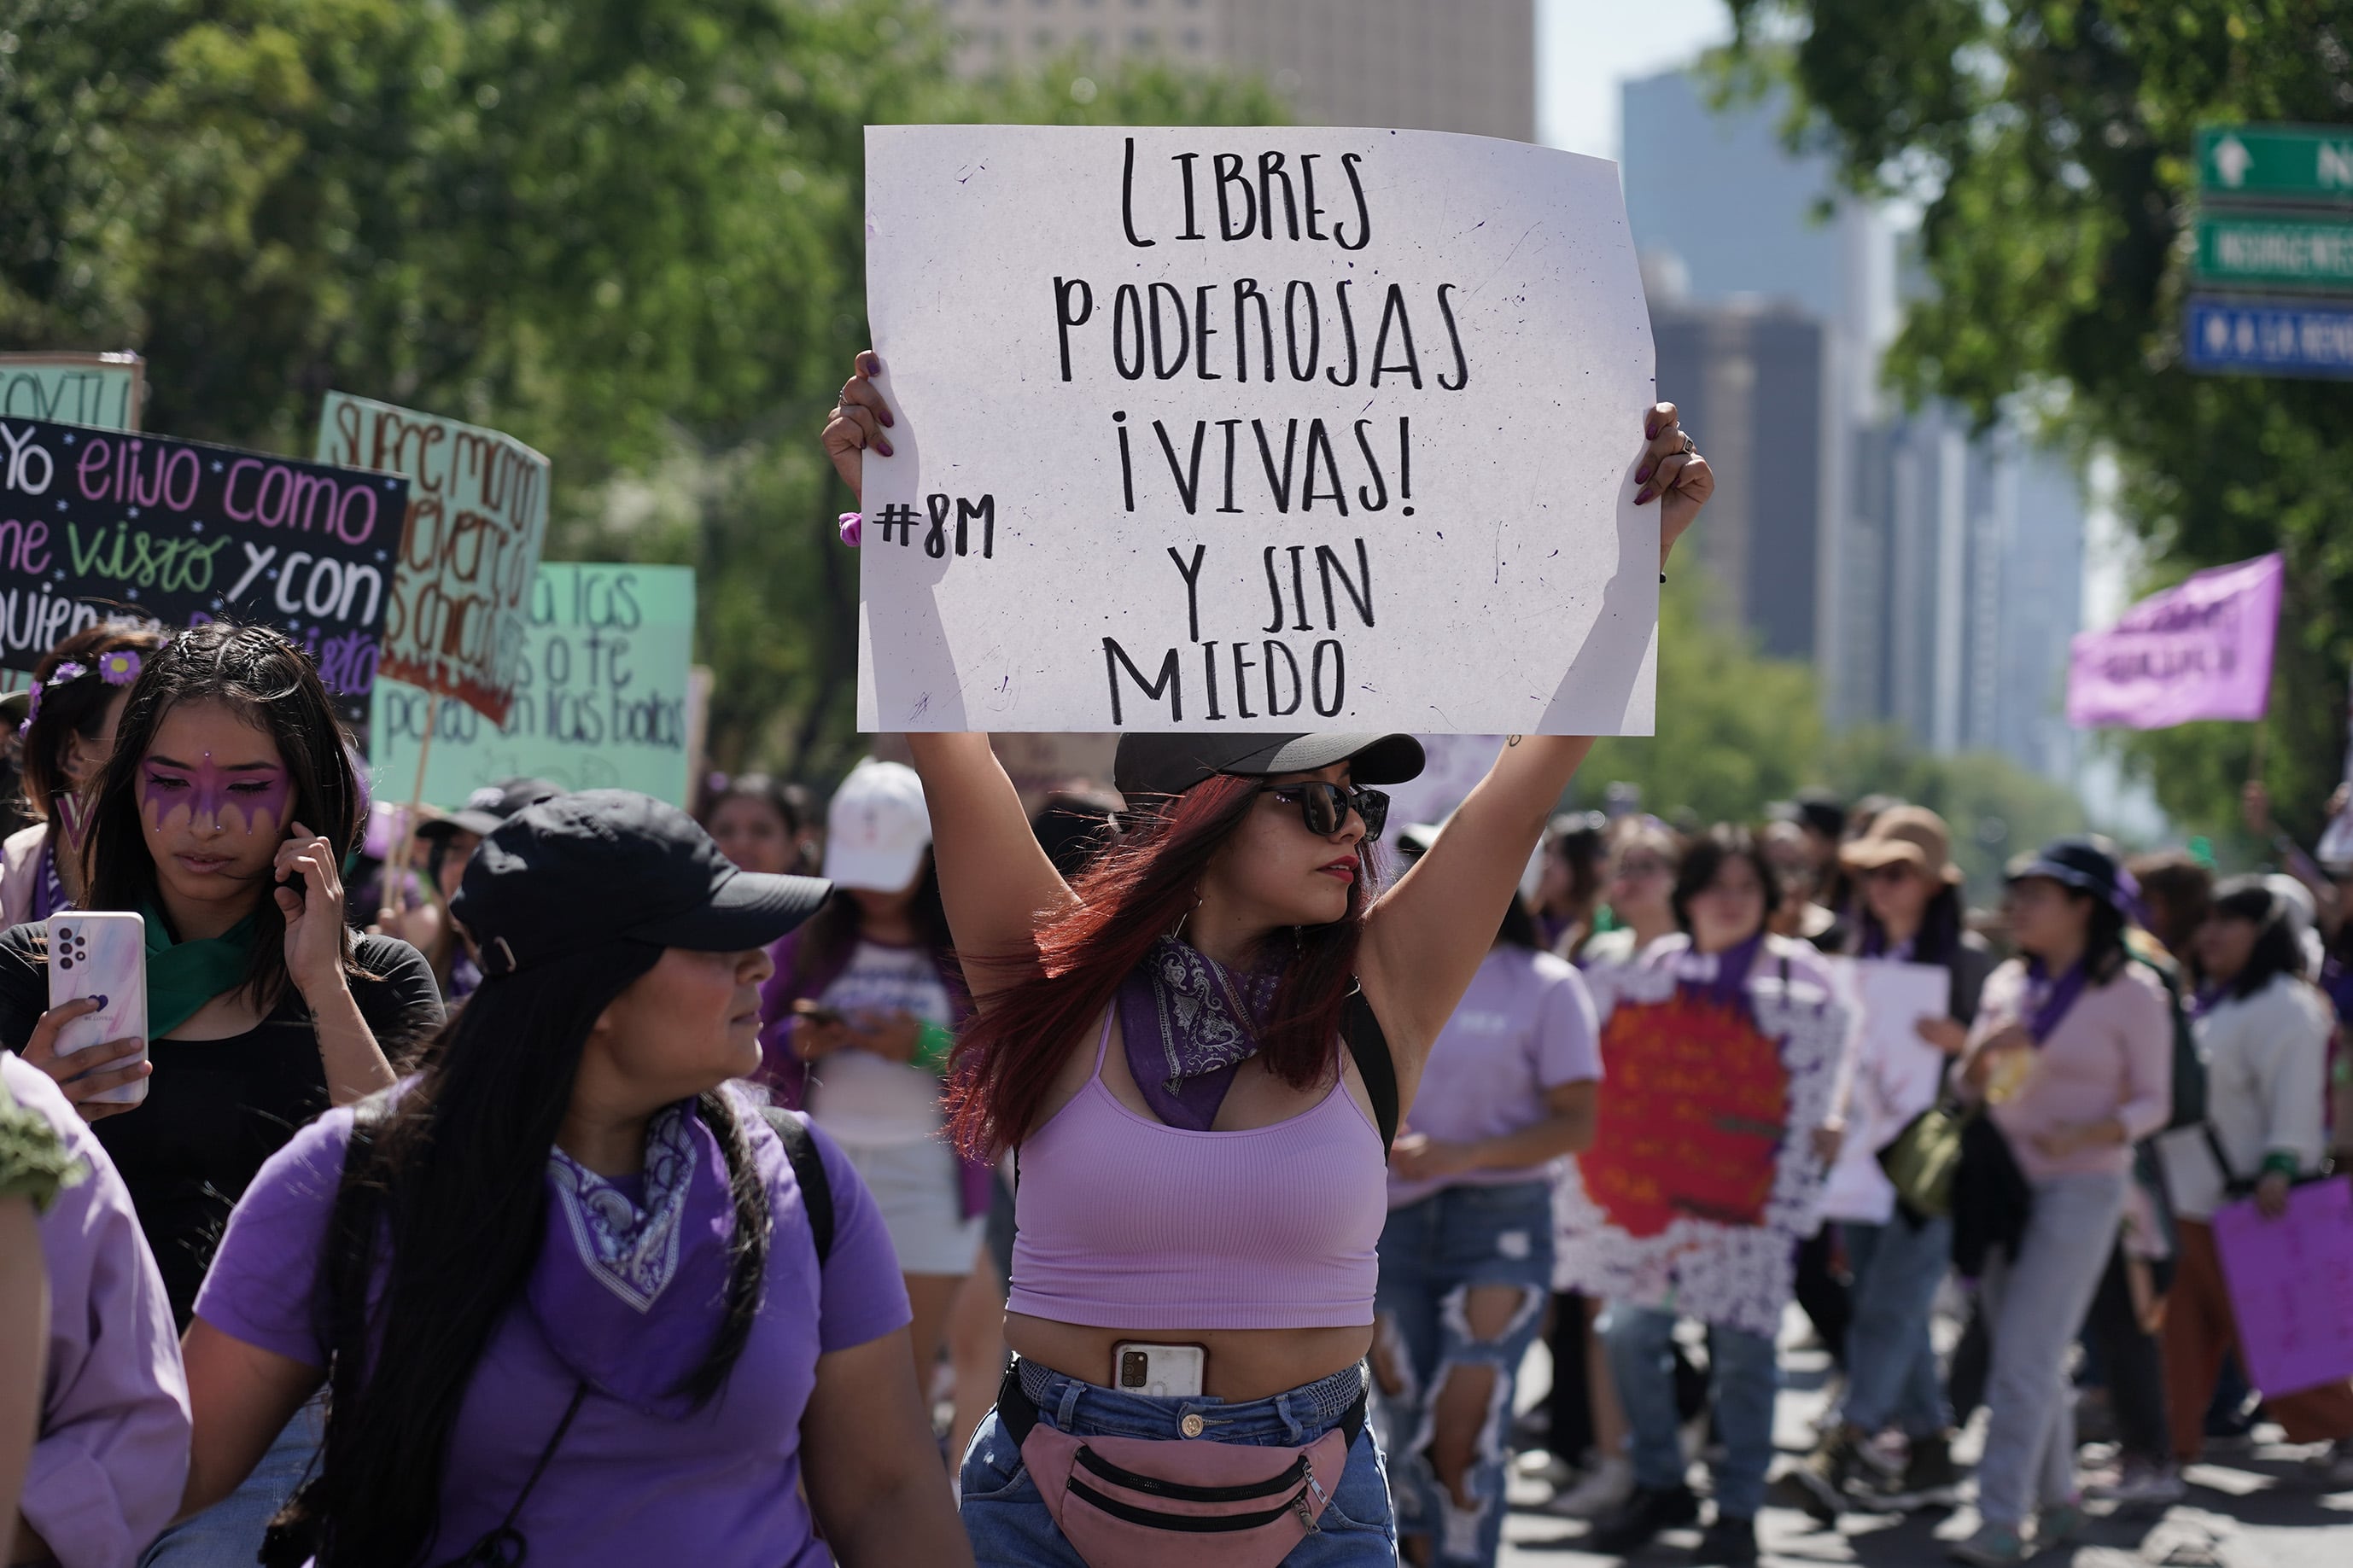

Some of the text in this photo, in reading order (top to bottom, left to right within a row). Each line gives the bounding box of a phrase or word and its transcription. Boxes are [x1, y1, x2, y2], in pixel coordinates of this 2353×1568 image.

[1121, 137, 1371, 251] LIBRES
[1053, 276, 1469, 391] PODEROSAS
[0, 421, 54, 495] Yo
[76, 437, 201, 511] elijo
[223, 458, 377, 545] como
[1112, 410, 1416, 517] ¡VIVAS!
[872, 493, 996, 559] #8M
[573, 564, 643, 634] las
[1167, 538, 1375, 643] Y SIN
[545, 634, 571, 686] o
[545, 686, 606, 746] las
